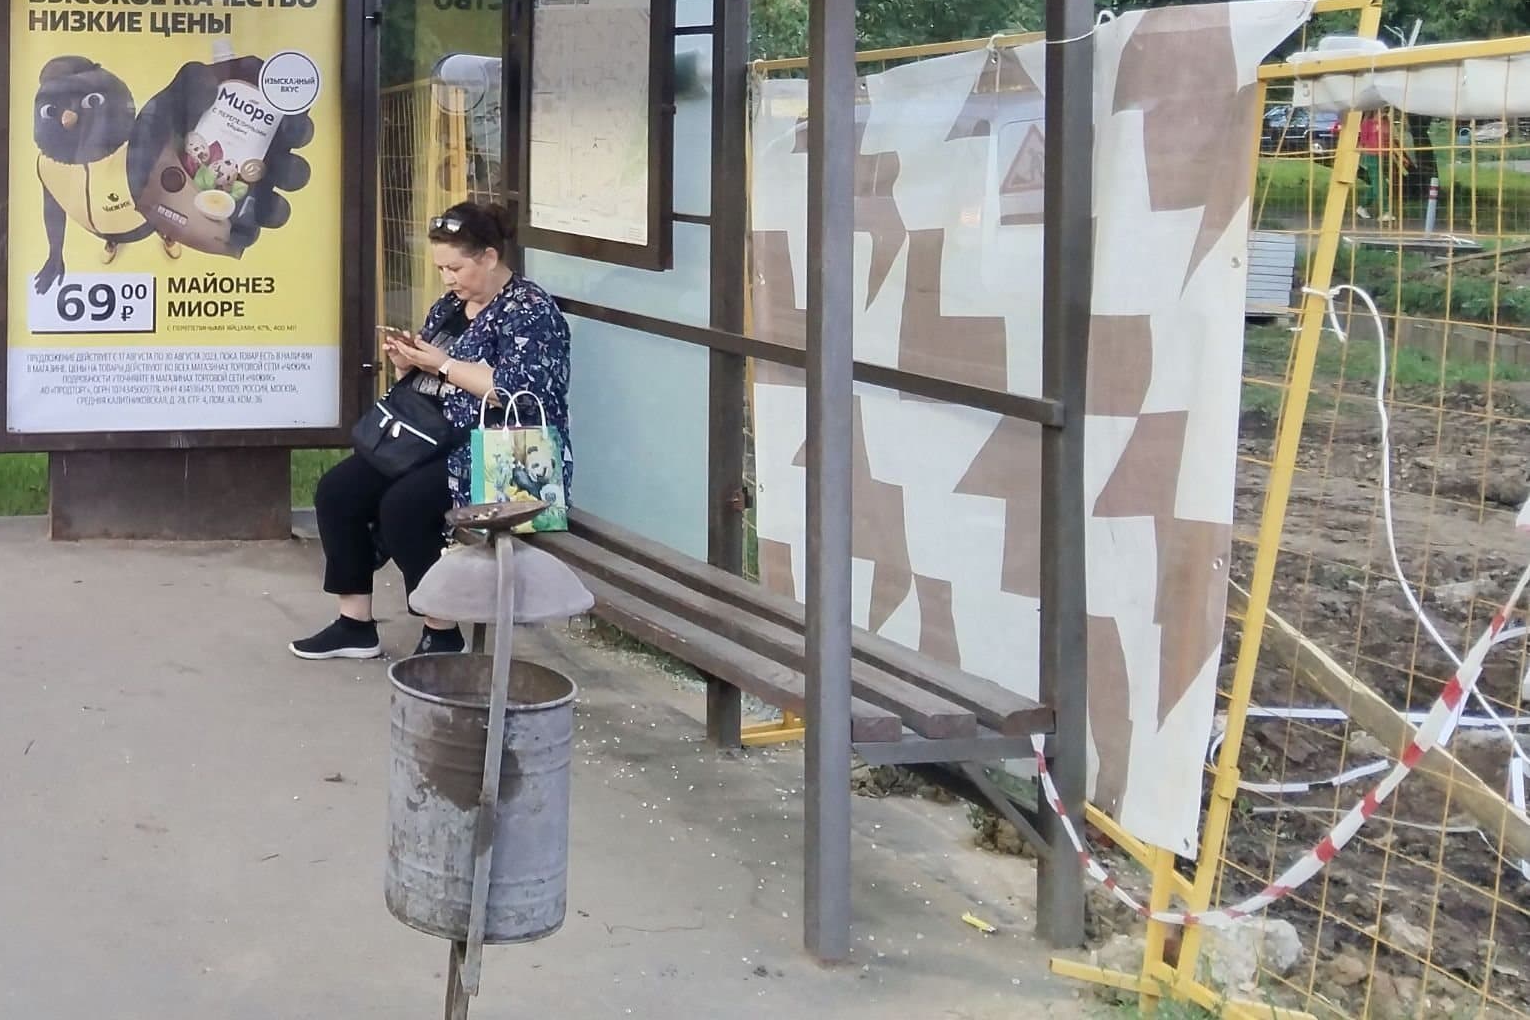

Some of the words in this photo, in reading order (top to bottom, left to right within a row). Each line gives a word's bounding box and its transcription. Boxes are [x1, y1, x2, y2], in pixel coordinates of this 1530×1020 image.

[28, 9, 143, 32] НИЗКИЕ
[150, 12, 232, 37] ЦЕНЫ
[264, 76, 315, 86] ИЗЫСКАННЫЙ
[280, 85, 300, 93] ВКУС
[167, 273, 276, 294] МАЙОНЕЗ
[56, 283, 117, 322] 69
[120, 284, 148, 300] 00
[167, 301, 245, 318] МИОРЕ
